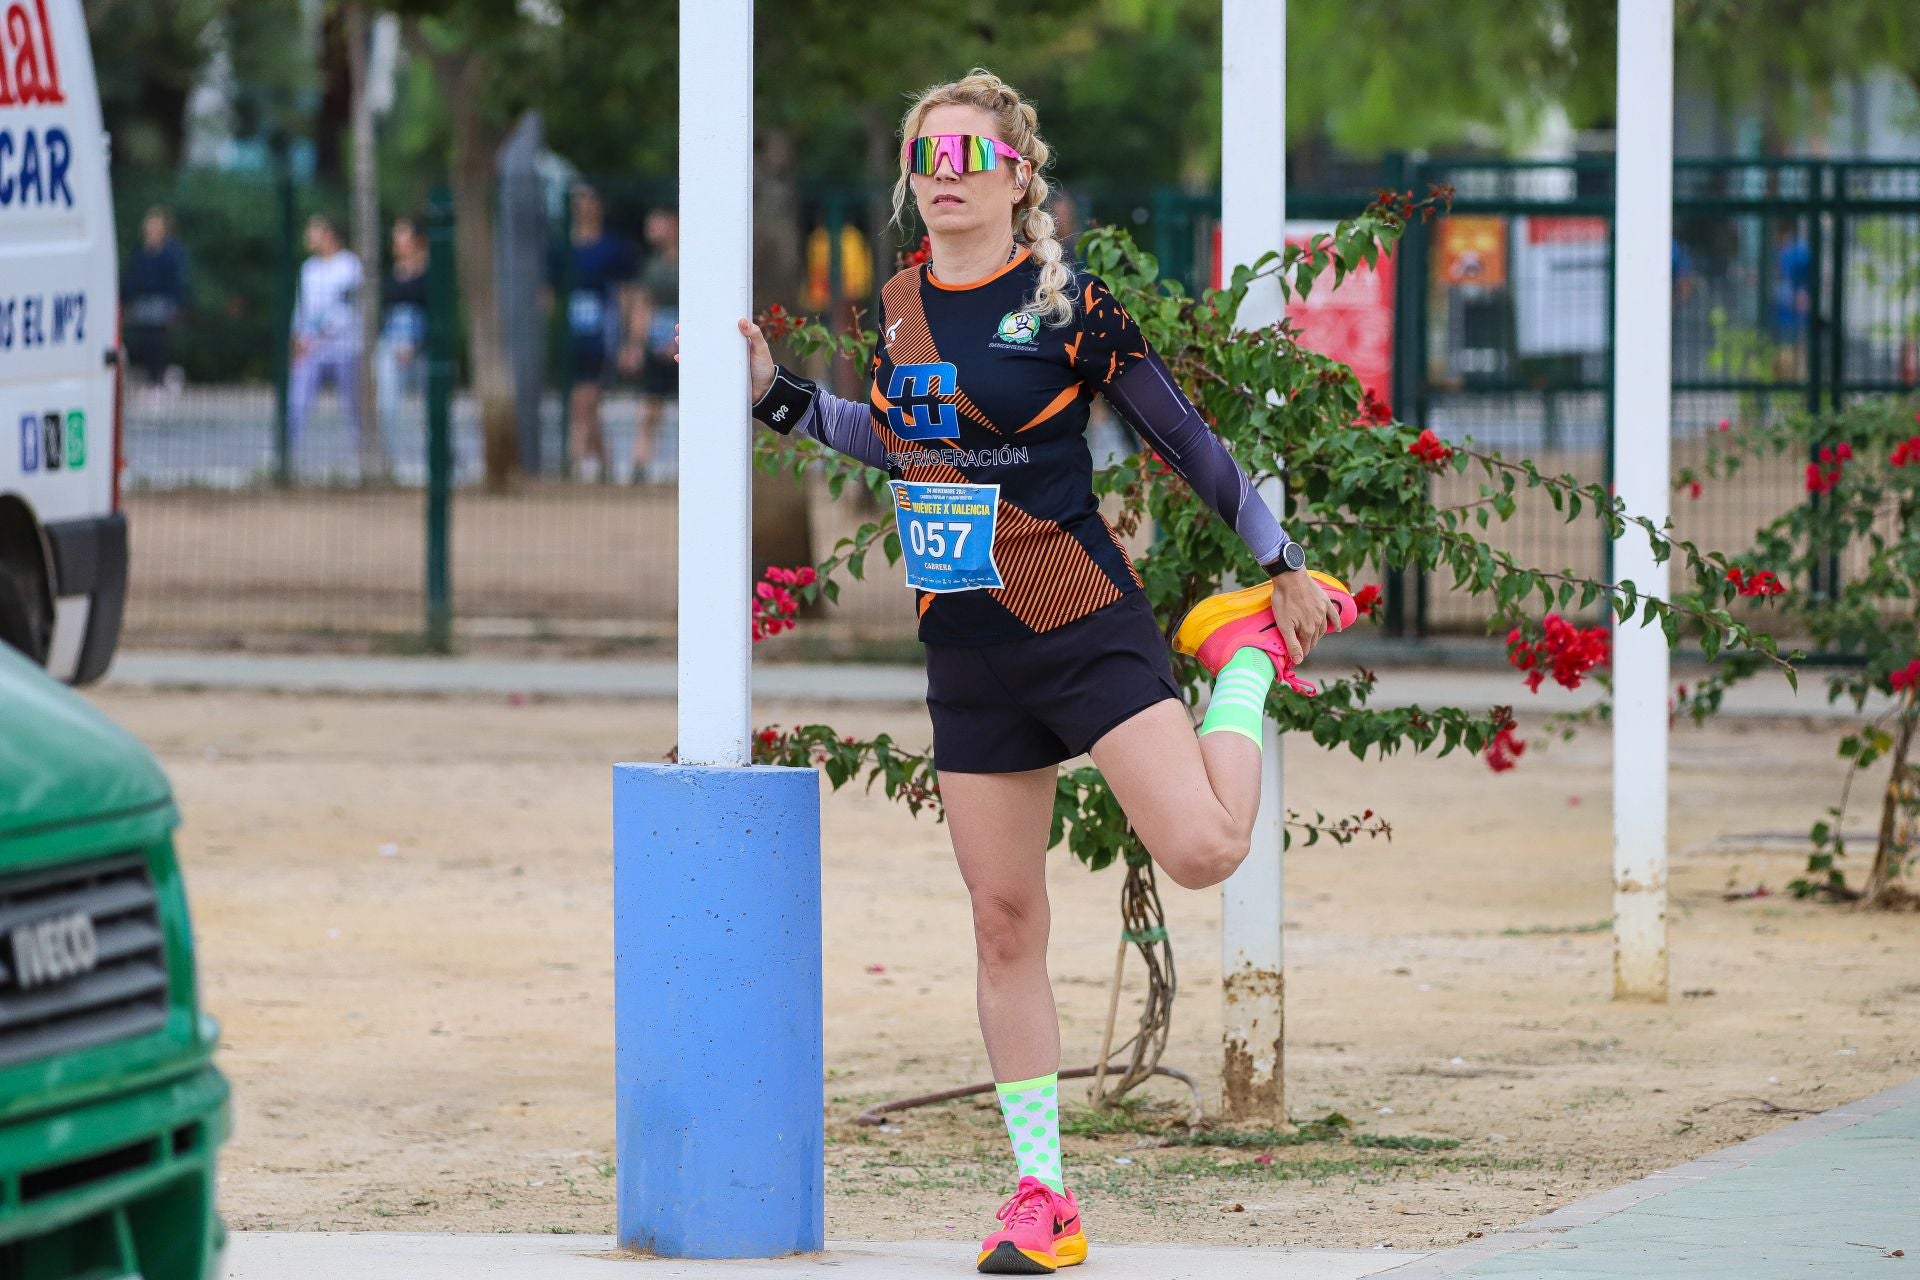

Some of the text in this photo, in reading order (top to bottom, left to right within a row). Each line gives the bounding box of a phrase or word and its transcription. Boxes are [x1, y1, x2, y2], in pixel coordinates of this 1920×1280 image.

[0, 0, 66, 106] al
[951, 504, 991, 516] VALENCIA
[909, 519, 973, 559] 057
[924, 562, 953, 571] CABRERA
